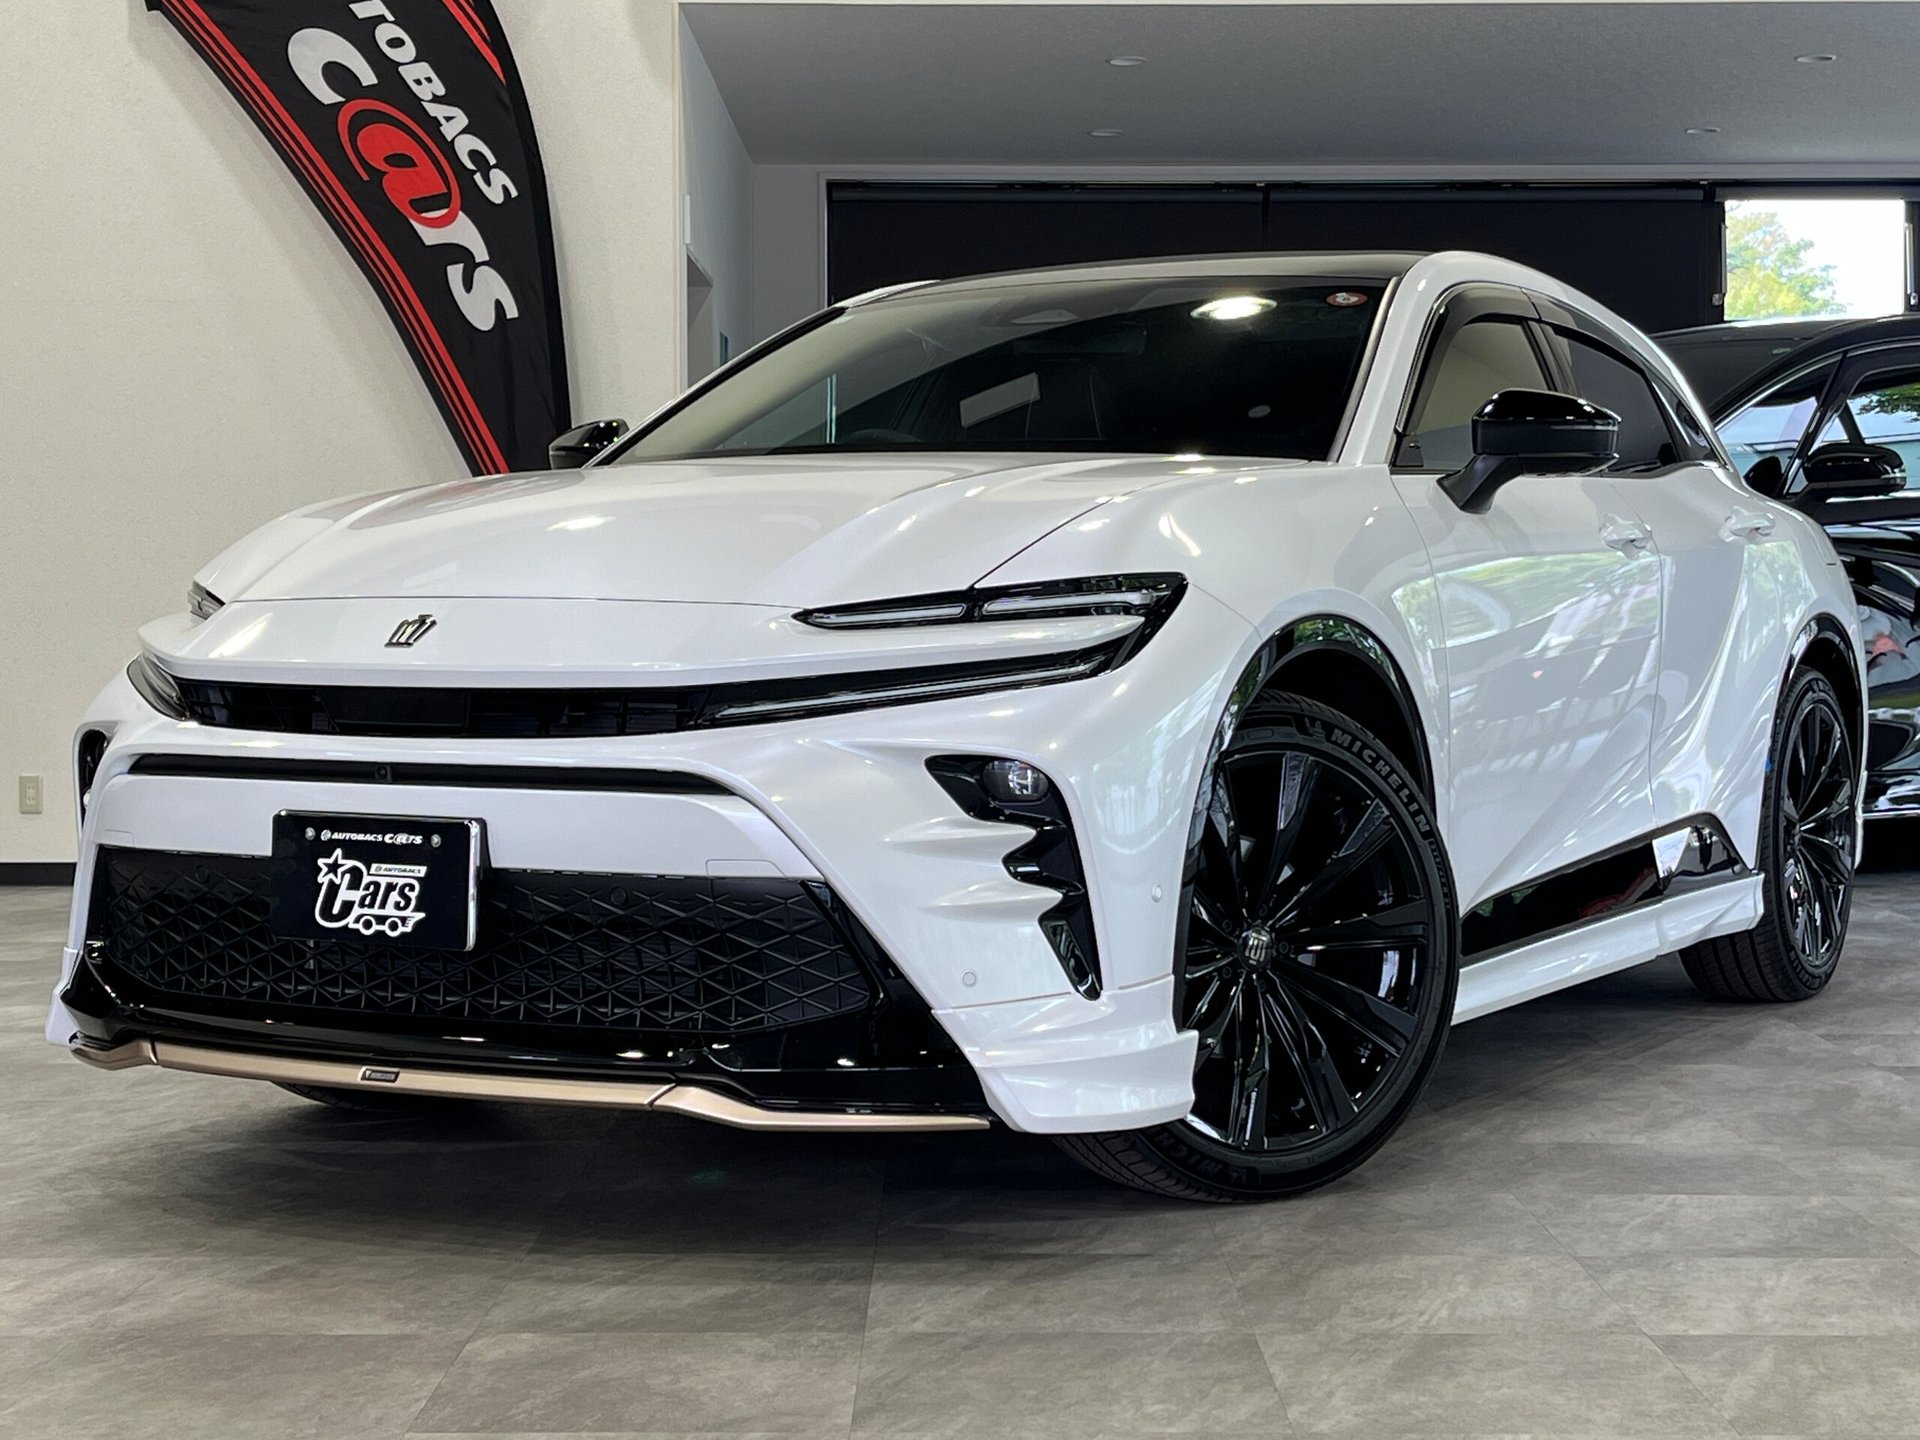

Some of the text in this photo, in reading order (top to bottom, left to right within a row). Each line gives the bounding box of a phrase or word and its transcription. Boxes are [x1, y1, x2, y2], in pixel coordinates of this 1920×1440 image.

[1330, 728, 1432, 834] MICHELIN
[331, 832, 383, 842] AUTOBACS
[316, 861, 418, 926] Cars
